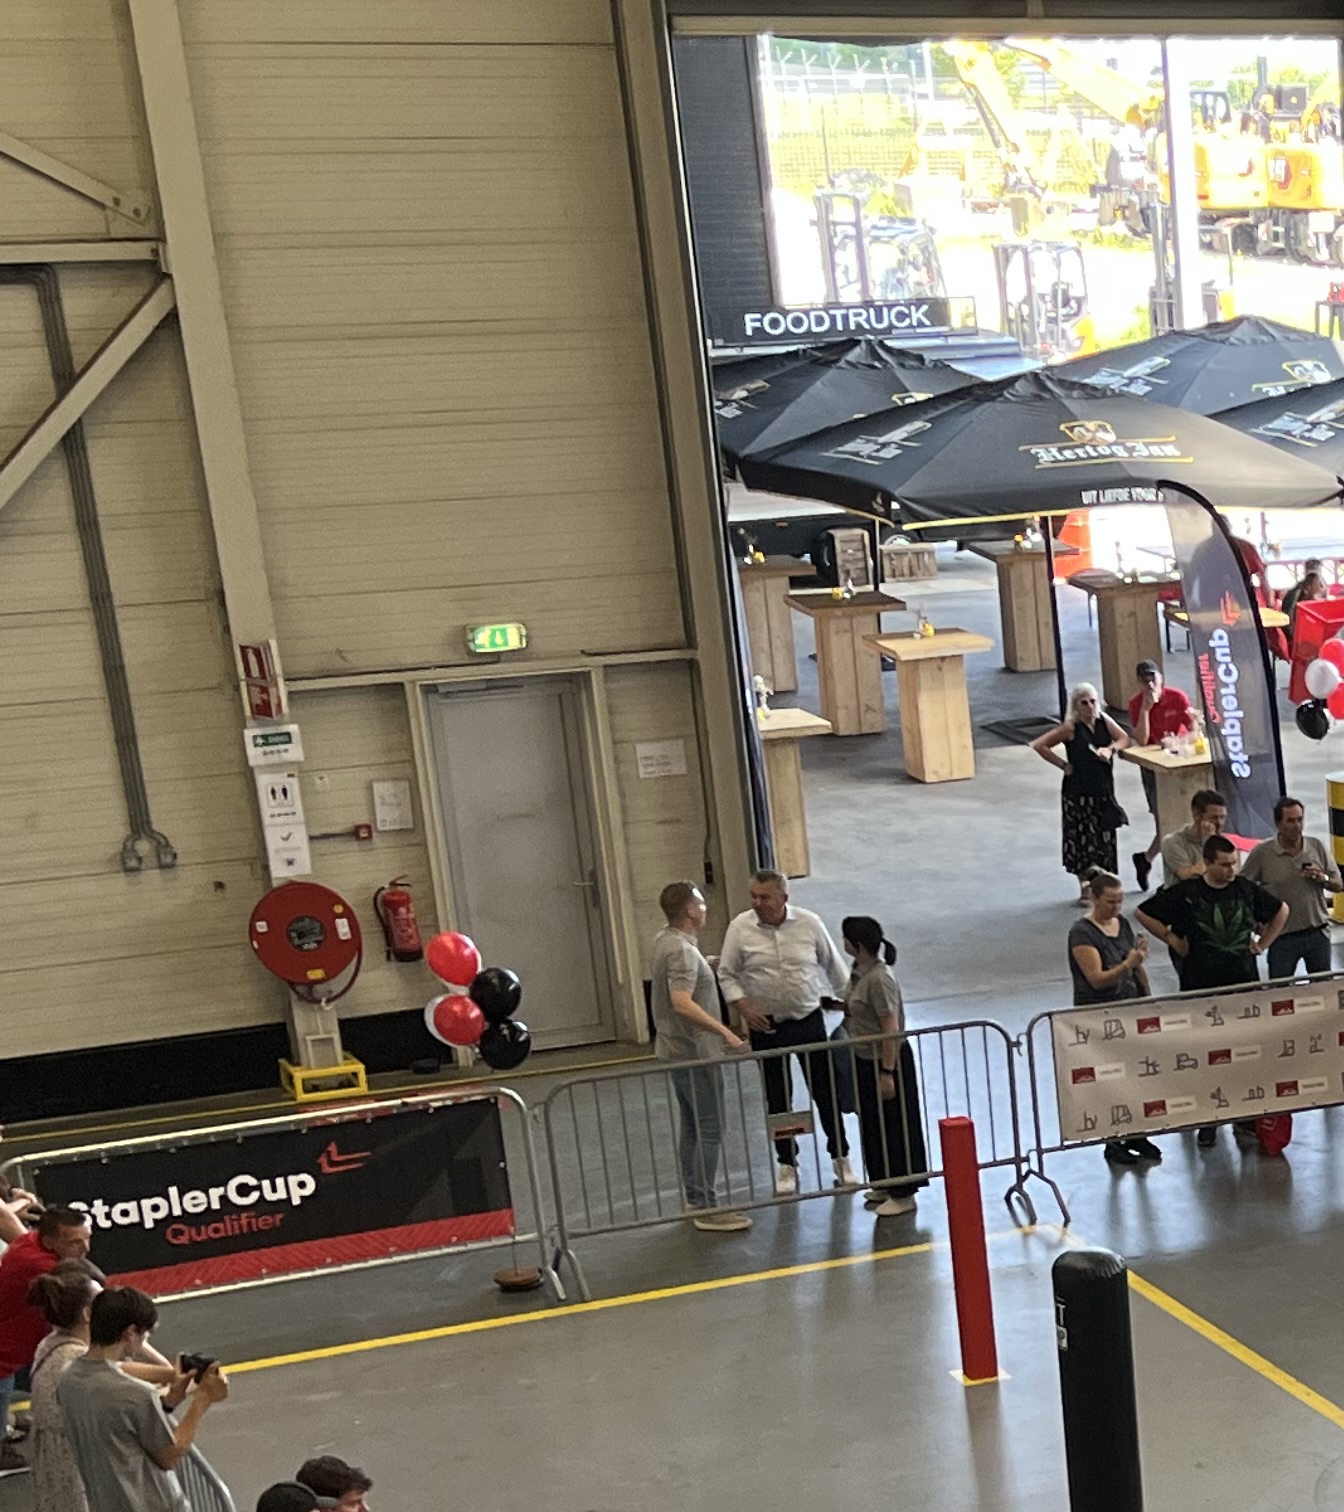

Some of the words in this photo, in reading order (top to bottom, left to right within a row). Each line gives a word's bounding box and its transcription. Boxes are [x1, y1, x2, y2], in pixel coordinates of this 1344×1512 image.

[743, 304, 932, 336] FOODTRUCK
[68, 1172, 317, 1230] StaplerCup
[164, 1211, 287, 1246] Qualifier
